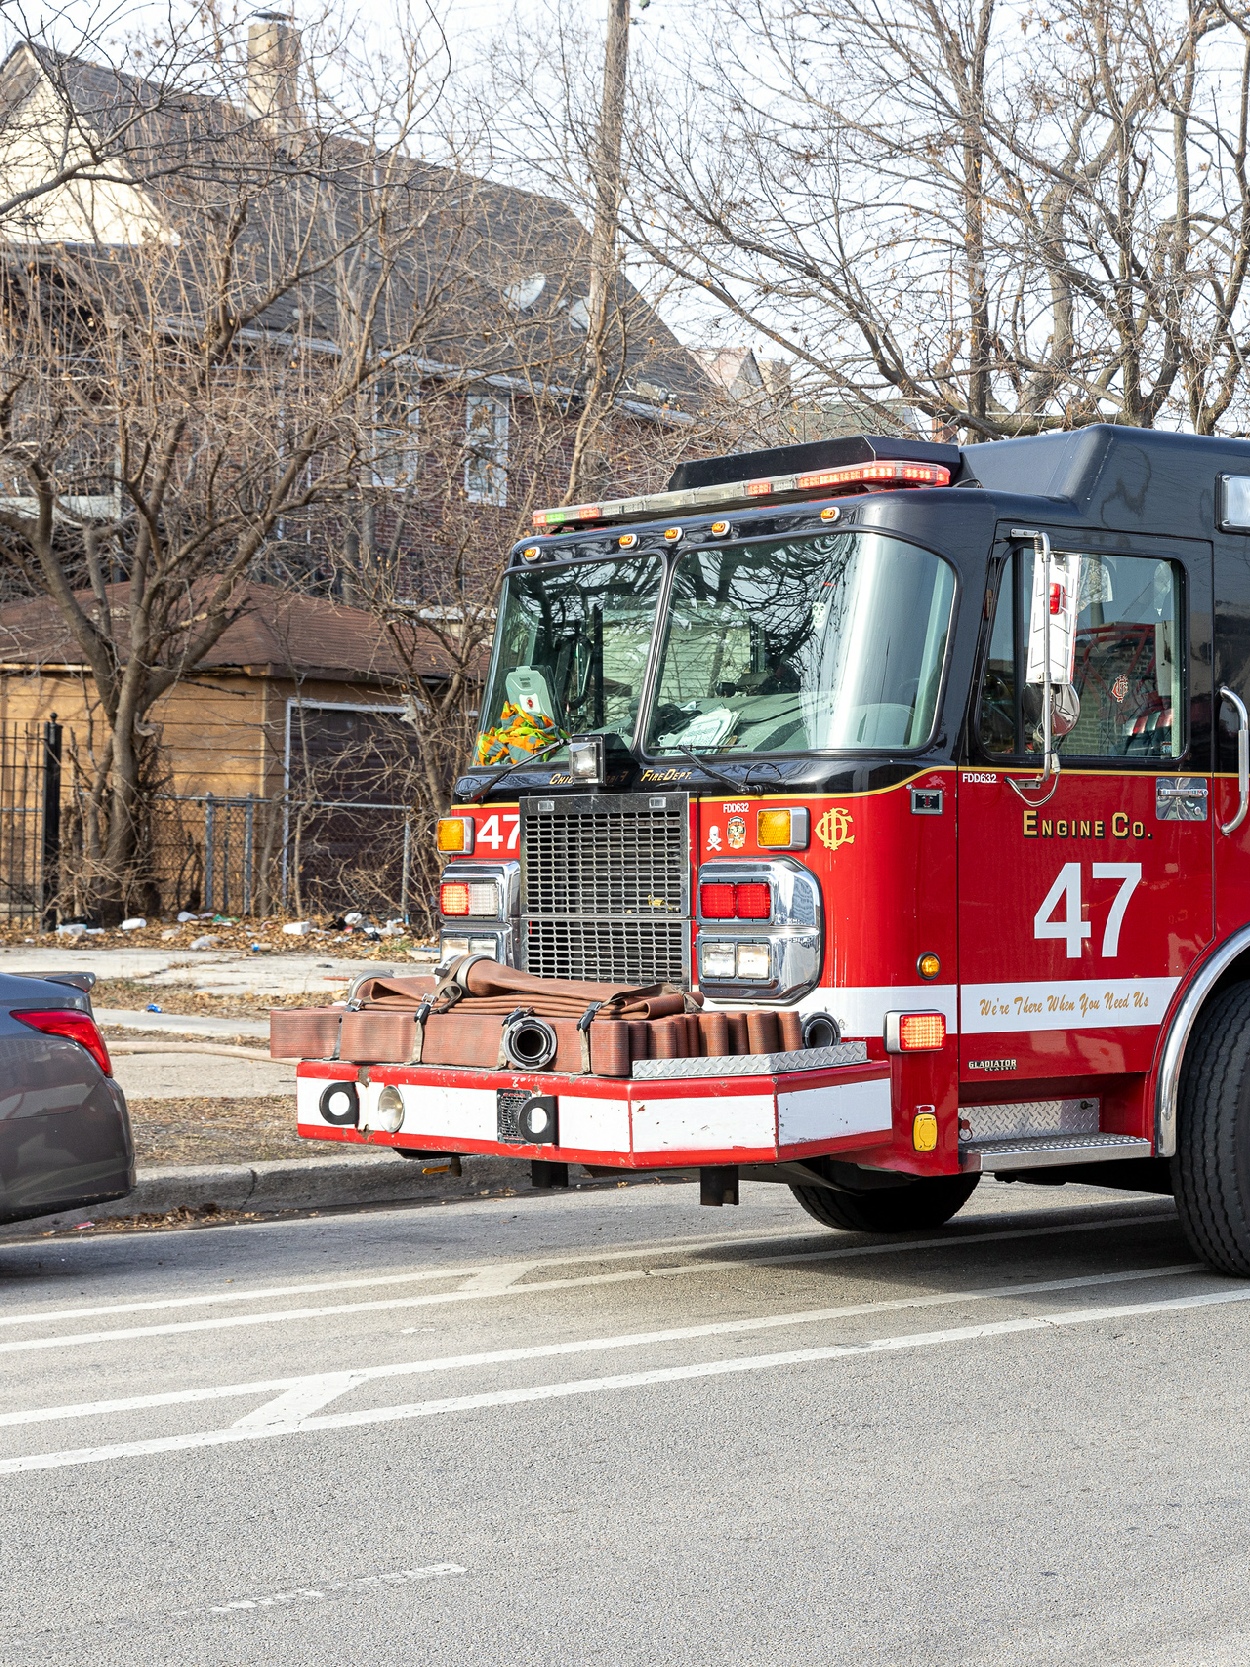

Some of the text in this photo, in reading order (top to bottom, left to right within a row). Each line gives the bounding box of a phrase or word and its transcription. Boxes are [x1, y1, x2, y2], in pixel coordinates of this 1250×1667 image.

[549, 773, 574, 785] CHIC
[962, 773, 997, 783] FDD632
[723, 803, 749, 813] FDD632
[476, 814, 520, 850] 47
[1022, 810, 1153, 840] ENGINE CO.
[1034, 862, 1142, 958] 47
[979, 991, 1149, 1018] We're There When You Need Us
[968, 1059, 1017, 1070] GLADIATOR
